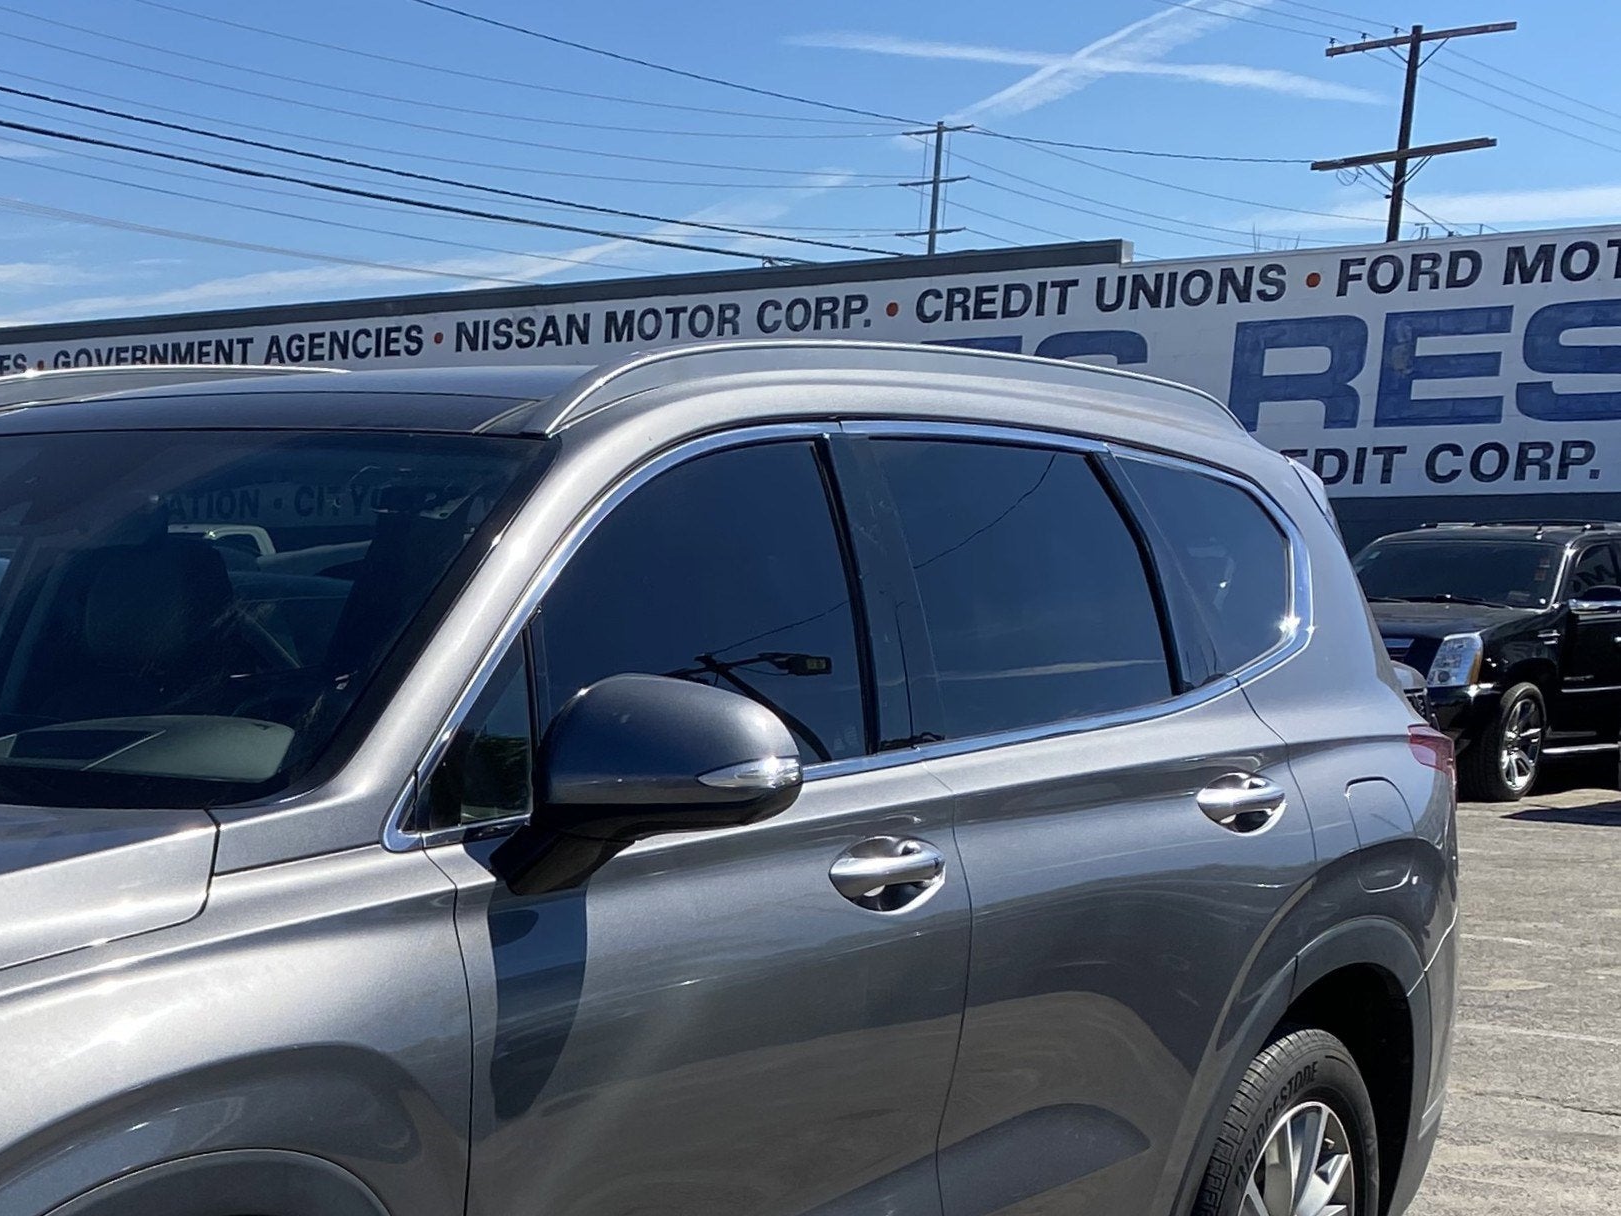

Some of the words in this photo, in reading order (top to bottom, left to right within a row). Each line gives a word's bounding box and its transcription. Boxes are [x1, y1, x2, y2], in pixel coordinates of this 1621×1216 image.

[53, 336, 254, 369] GOVERNMENT
[264, 324, 424, 366] AGENCIES
[454, 312, 590, 354] NISSAN
[603, 302, 740, 344] MOTOR
[756, 293, 872, 333] CORP.
[915, 278, 1079, 324] CREDIT
[1096, 262, 1287, 313] UNIONS
[1336, 248, 1483, 298] FORD
[1425, 439, 1601, 485] CORP.
